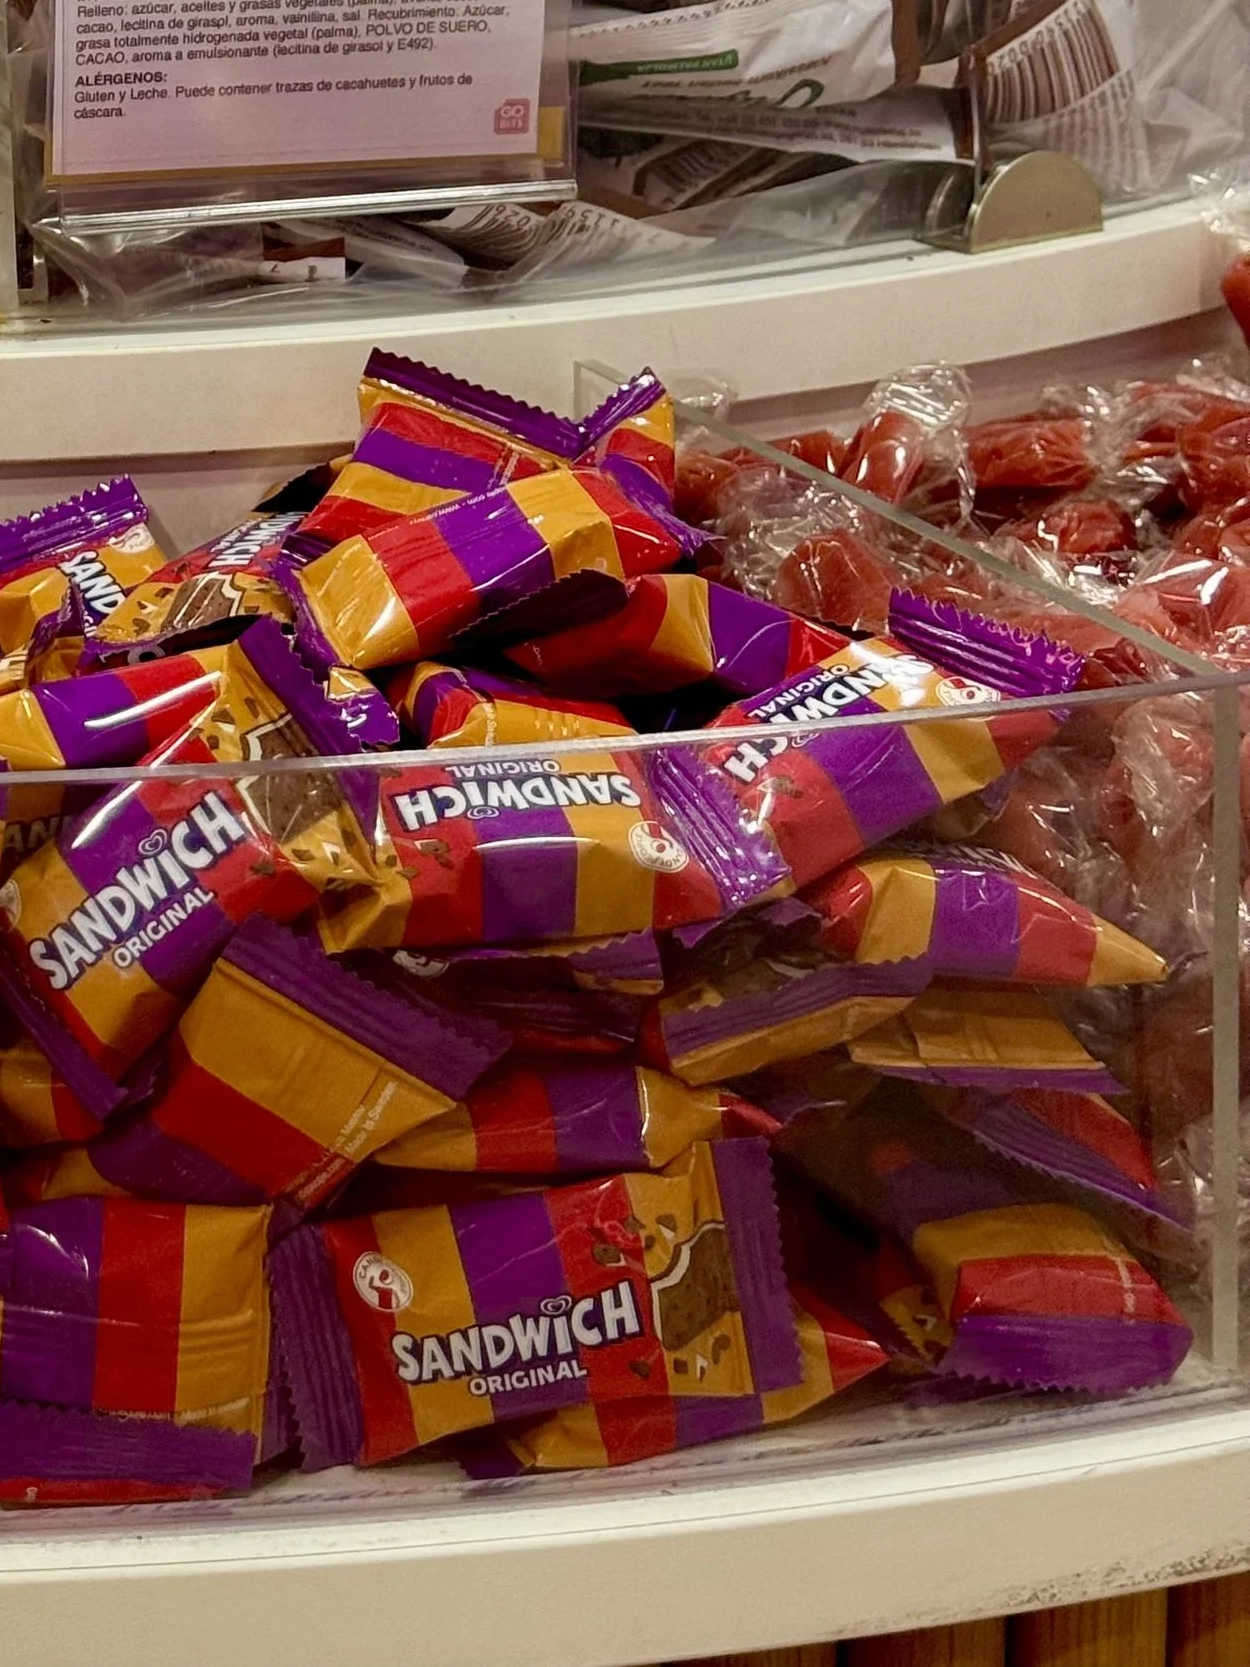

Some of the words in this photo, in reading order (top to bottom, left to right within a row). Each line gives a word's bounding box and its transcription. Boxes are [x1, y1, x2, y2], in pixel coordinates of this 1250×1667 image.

[181, 0, 225, 13] aceites
[229, 1, 236, 14] y
[239, 0, 281, 13] grasas
[76, 39, 110, 52] grasa
[114, 33, 179, 48] totalmente
[183, 30, 260, 46] hidrogenada
[263, 27, 308, 43] vegetal
[366, 22, 413, 37] POLVO
[416, 21, 435, 34] DE
[121, 18, 164, 32] lecitina
[168, 18, 184, 29] de
[132, 51, 172, 63] aroma
[175, 50, 183, 61] a
[187, 46, 268, 60] emulsionante
[273, 44, 320, 58] (lecitina
[323, 42, 338, 54] de
[342, 40, 383, 56] girasol
[386, 41, 394, 54] y
[74, 91, 115, 103] Gluten
[119, 90, 126, 104] y
[176, 85, 215, 98] Puede
[218, 83, 272, 97] contener
[276, 82, 313, 93] trazas
[316, 79, 332, 92] de
[336, 77, 406, 91] cacahuetes
[409, 77, 416, 90] y
[420, 74, 454, 87] frutos
[457, 72, 473, 85] de
[747, 663, 849, 720] ORIGINAL
[445, 760, 560, 778] ORIGINAL
[393, 773, 641, 831] SANDWICH
[29, 791, 245, 989] SANDWICH
[112, 888, 213, 969] ORIGINAL
[391, 1280, 640, 1383] SANDWICH
[470, 1359, 587, 1397] ORIGINAL
